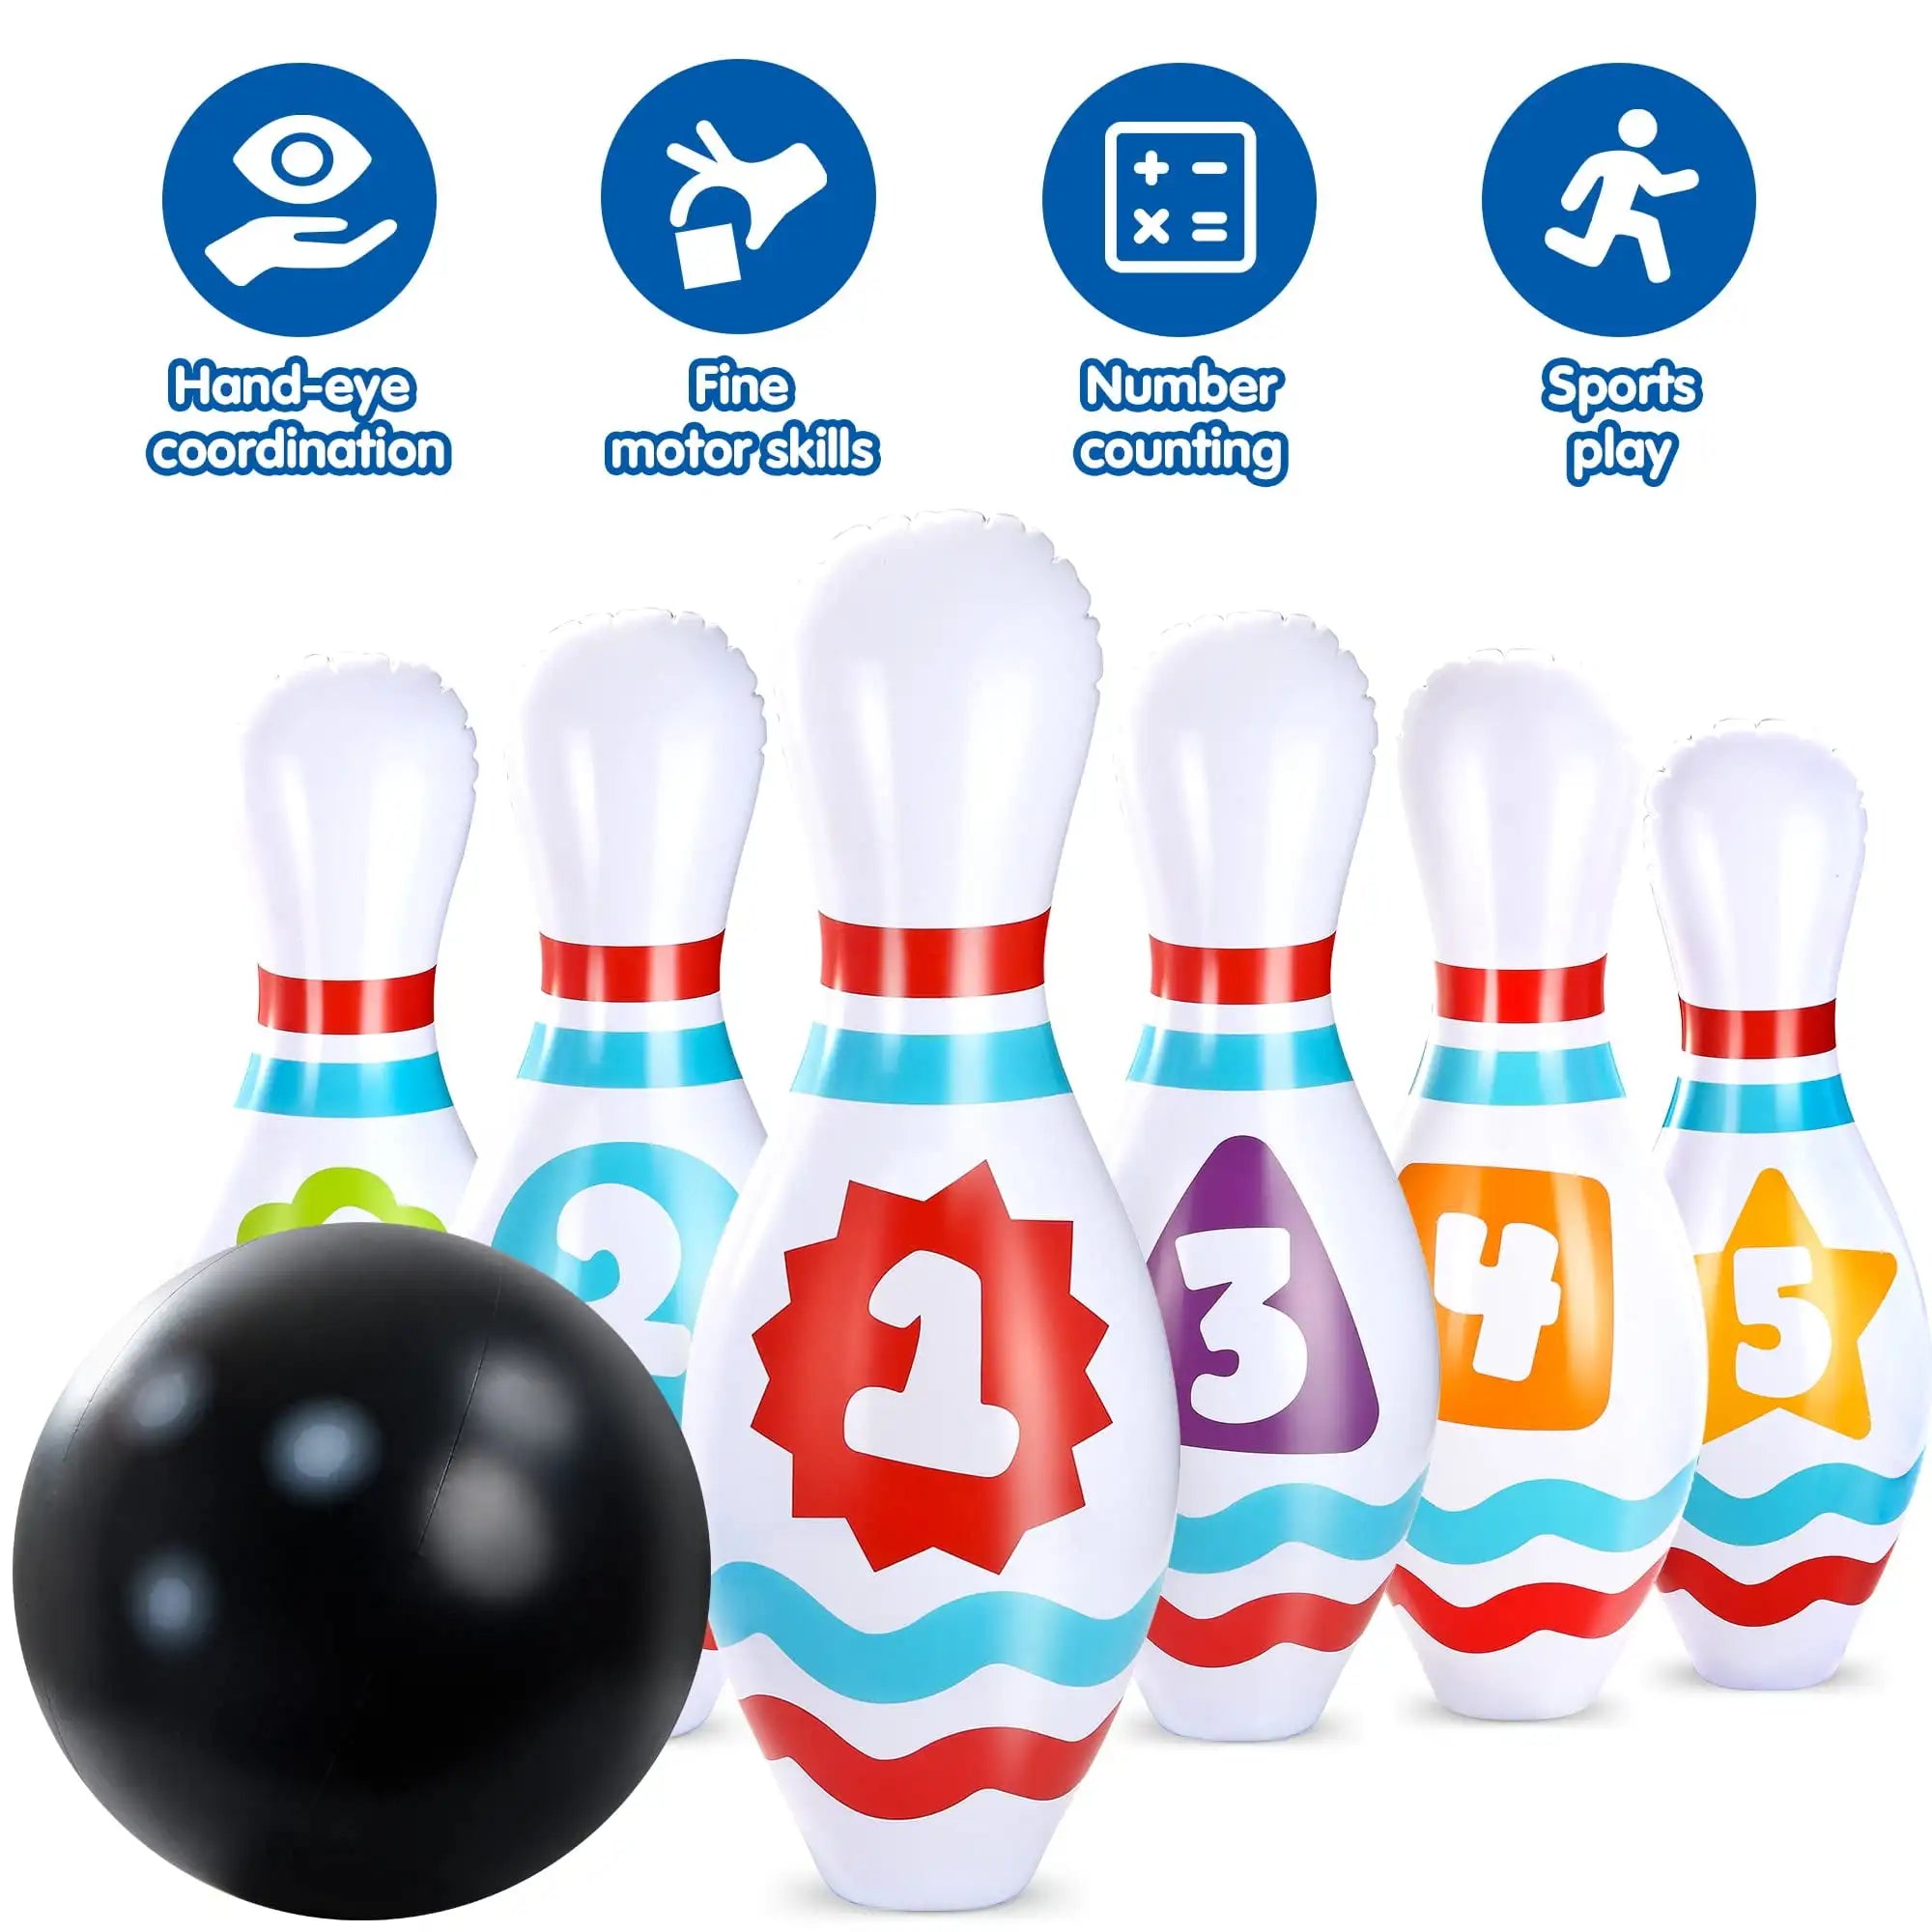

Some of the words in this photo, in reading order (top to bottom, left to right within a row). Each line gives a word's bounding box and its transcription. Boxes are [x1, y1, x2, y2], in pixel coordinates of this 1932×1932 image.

[556, 1182, 692, 1378] 2
[843, 1250, 1021, 1478] 1
[1175, 1227, 1309, 1424] 3
[1434, 1211, 1563, 1382] 4
[1733, 1245, 1833, 1398] 5
